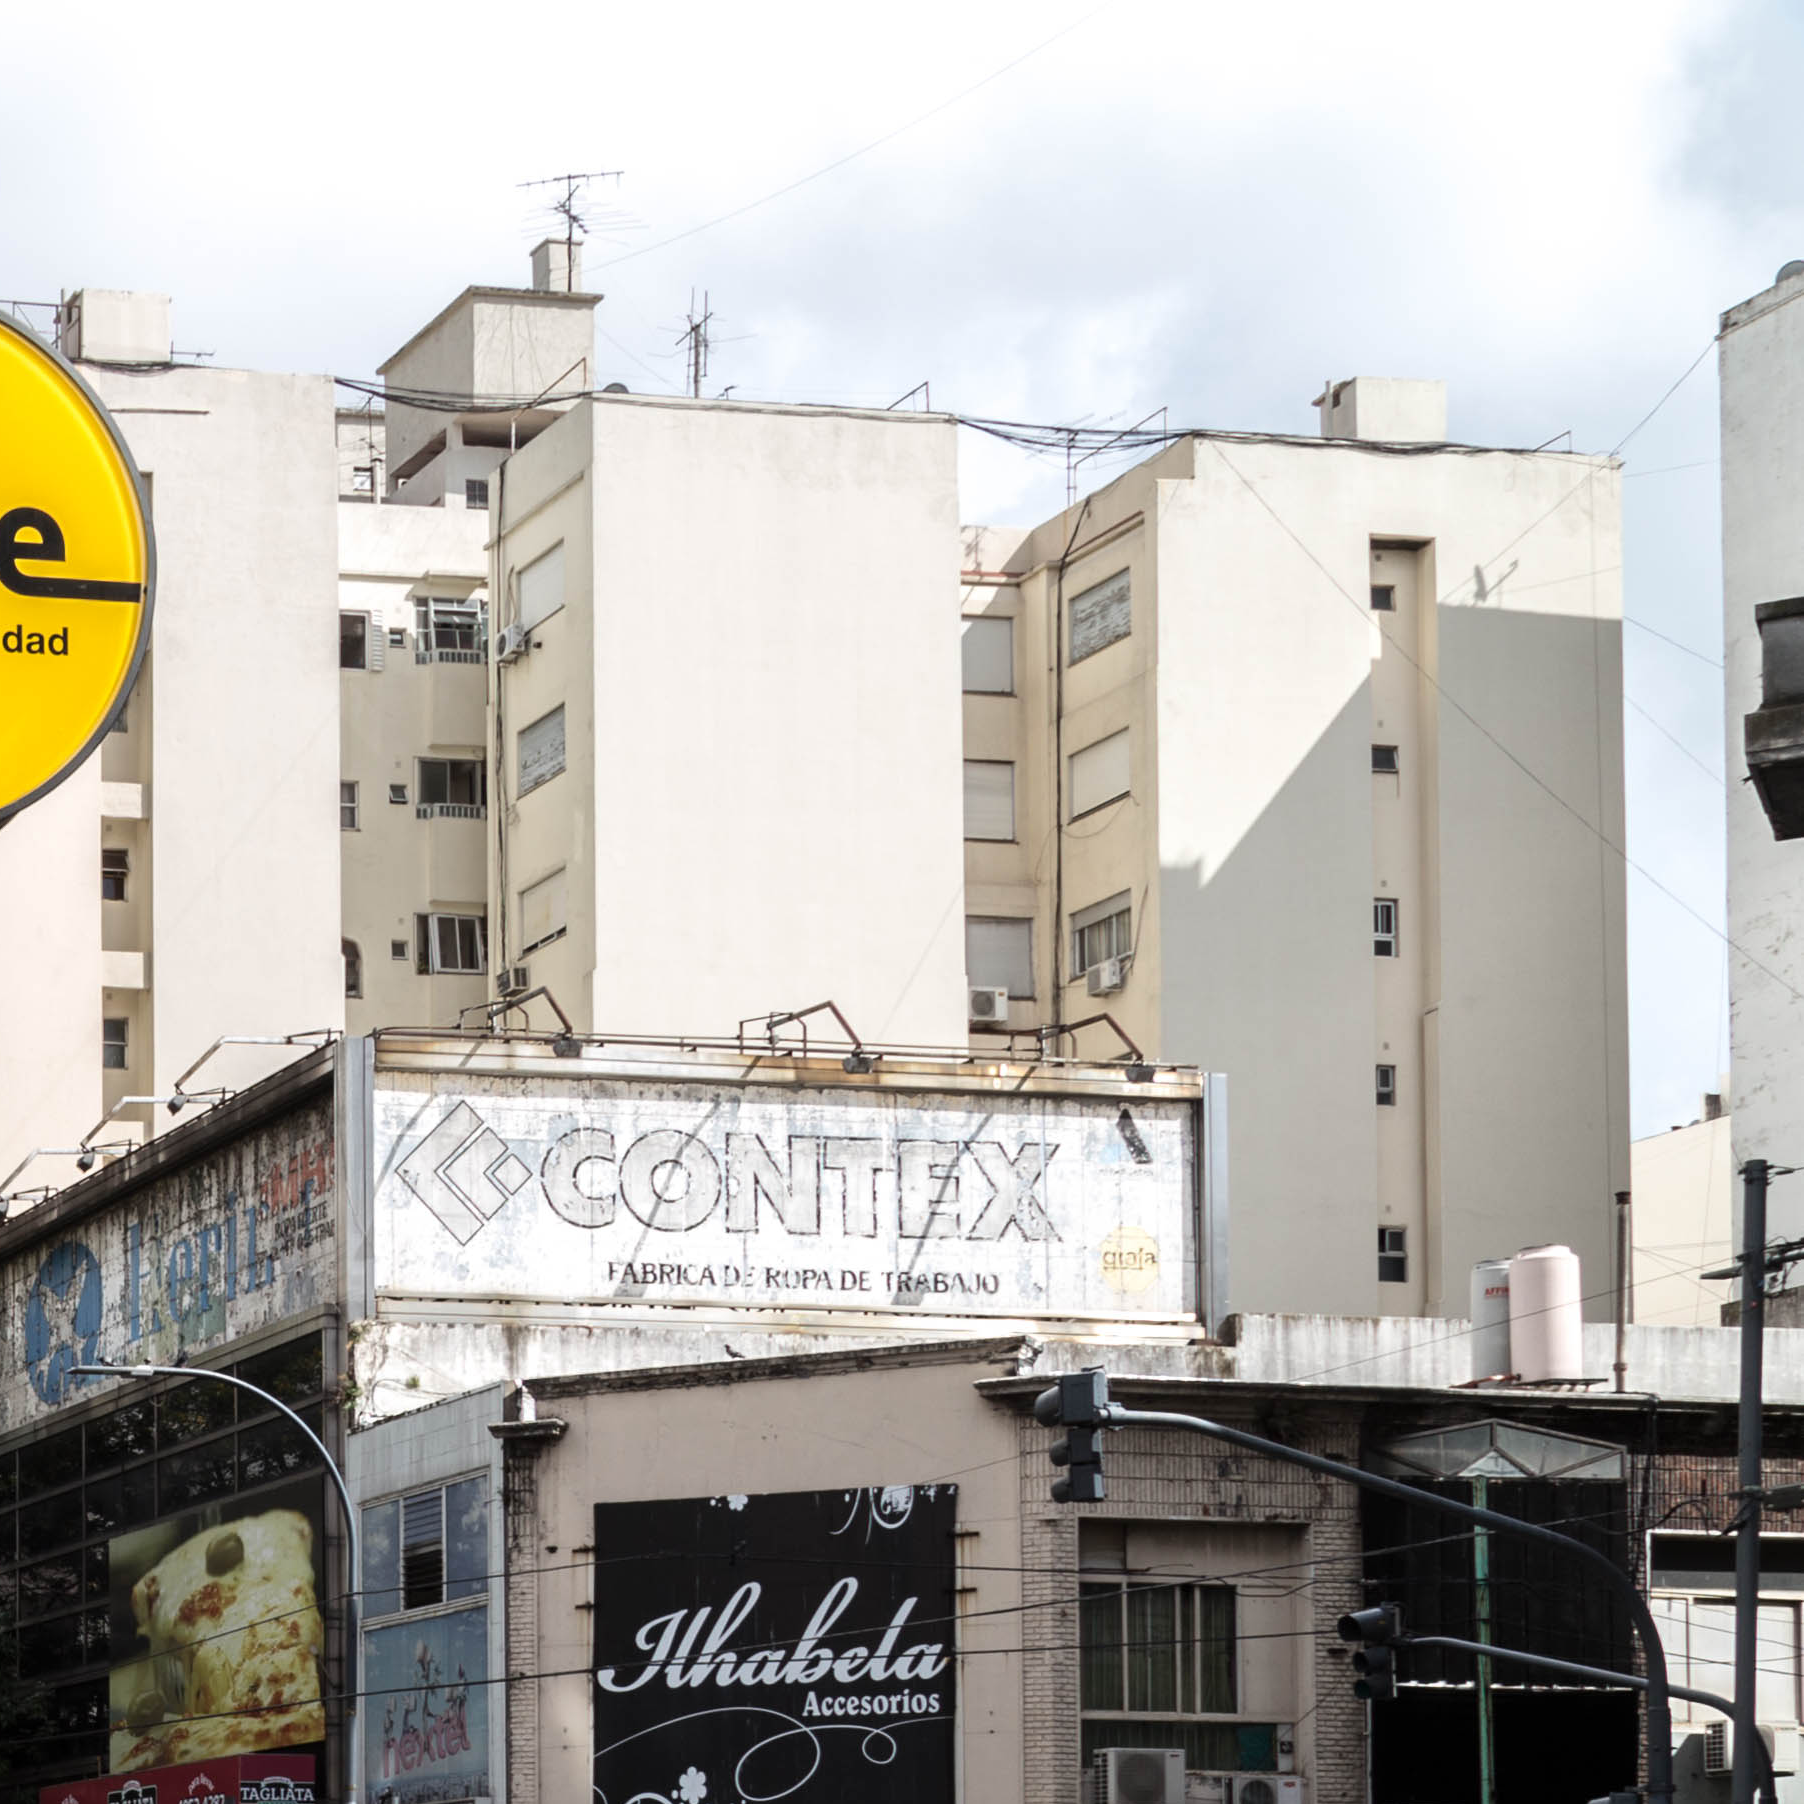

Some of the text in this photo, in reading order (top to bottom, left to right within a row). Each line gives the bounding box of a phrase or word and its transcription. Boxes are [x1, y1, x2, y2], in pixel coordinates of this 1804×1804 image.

[539, 1127, 1063, 1243] CONTEX
[608, 1261, 716, 1286] FABRICA
[765, 1266, 832, 1291] ROPA
[840, 1269, 873, 1292] DE
[881, 1271, 1001, 1296] TRABAJO
[597, 1575, 951, 1694] Ilhabela
[801, 1689, 941, 1719] Accesorios
[382, 1704, 472, 1779] nextel
[241, 1786, 315, 1801] TAGLIATA
